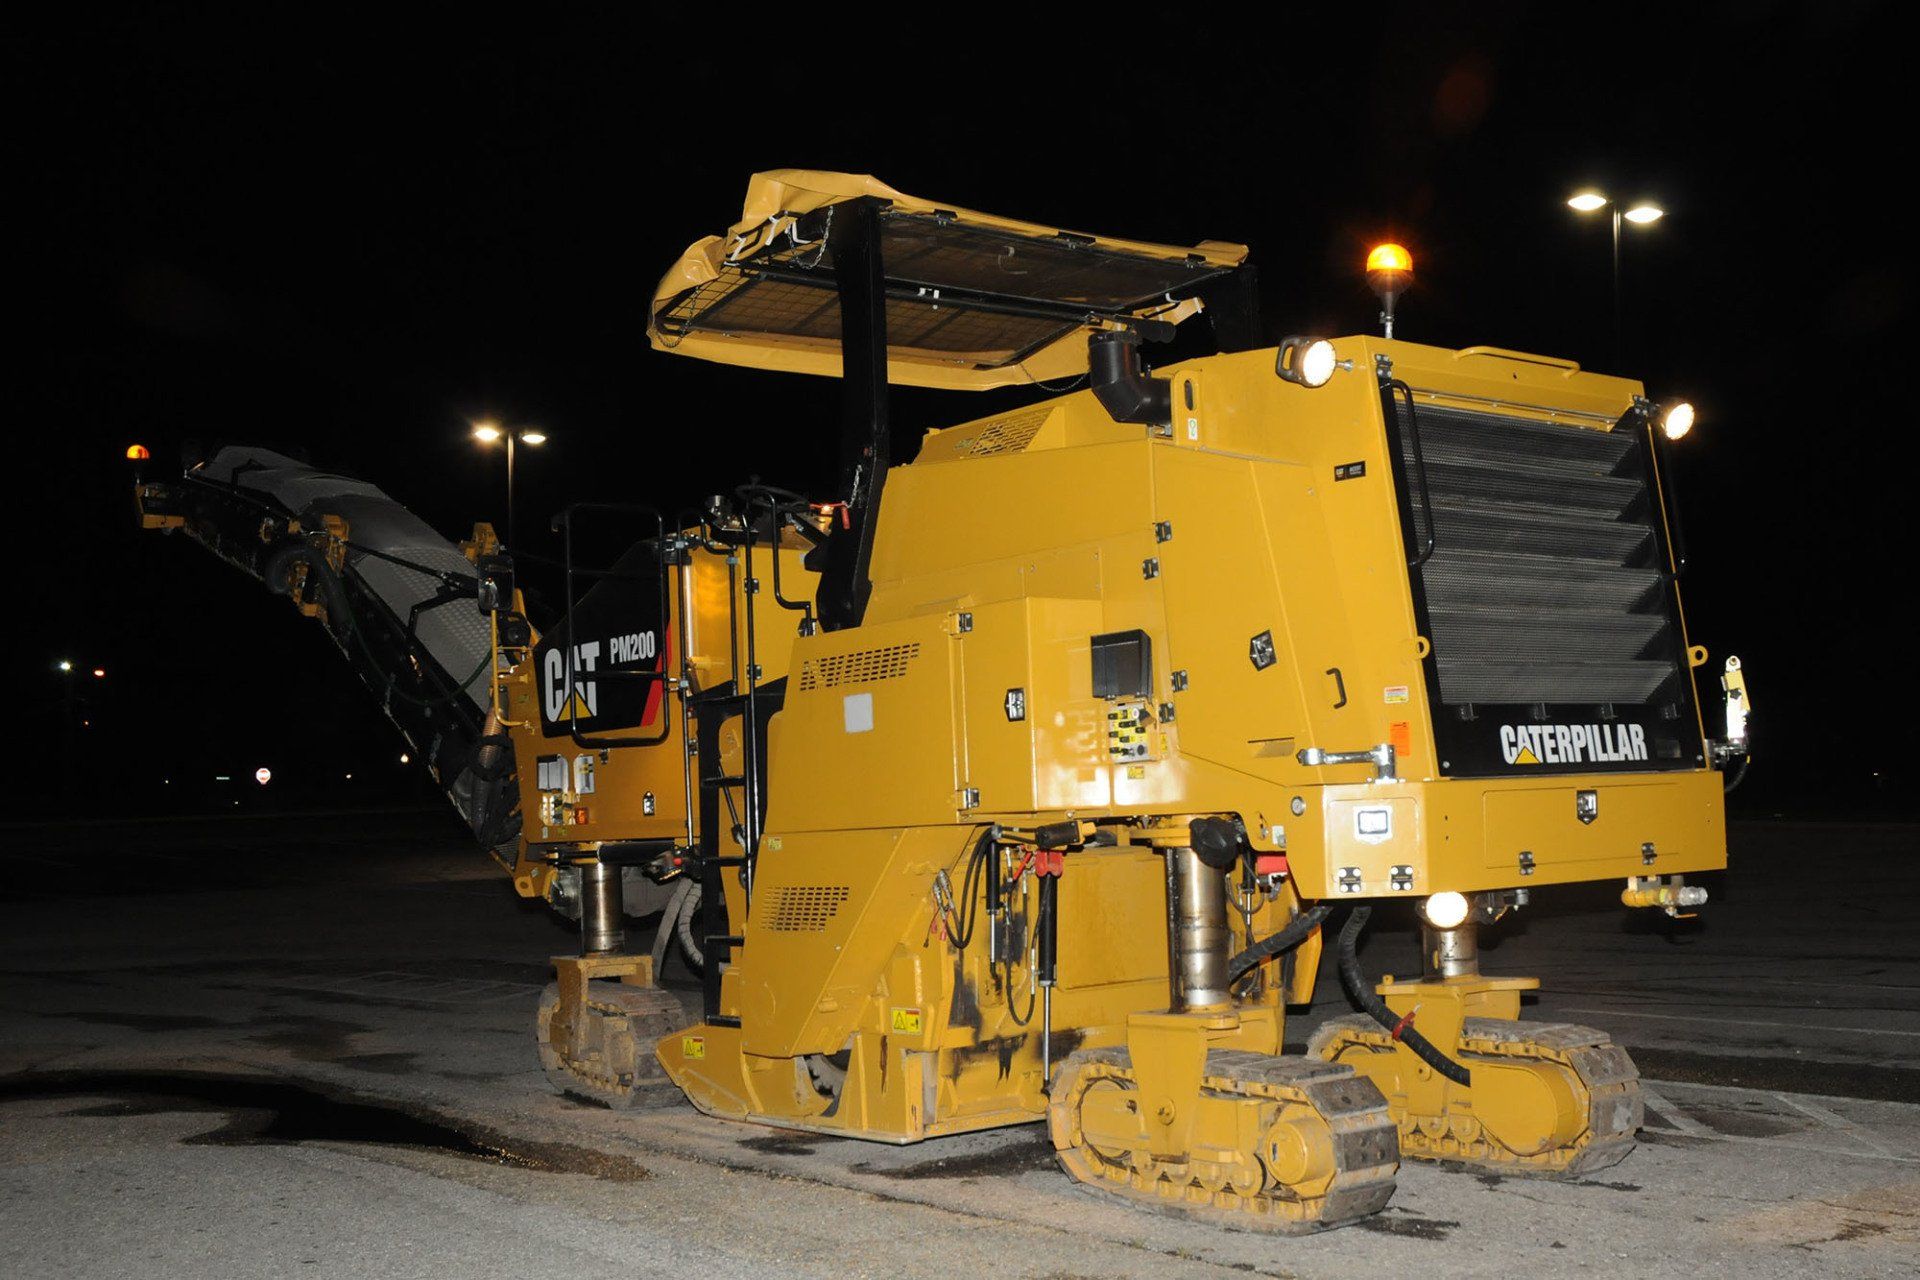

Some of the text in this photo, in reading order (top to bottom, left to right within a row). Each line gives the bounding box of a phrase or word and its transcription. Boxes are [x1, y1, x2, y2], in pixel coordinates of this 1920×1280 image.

[545, 631, 656, 722] CAT PM200
[1500, 724, 1648, 765] CATERPILLAR
